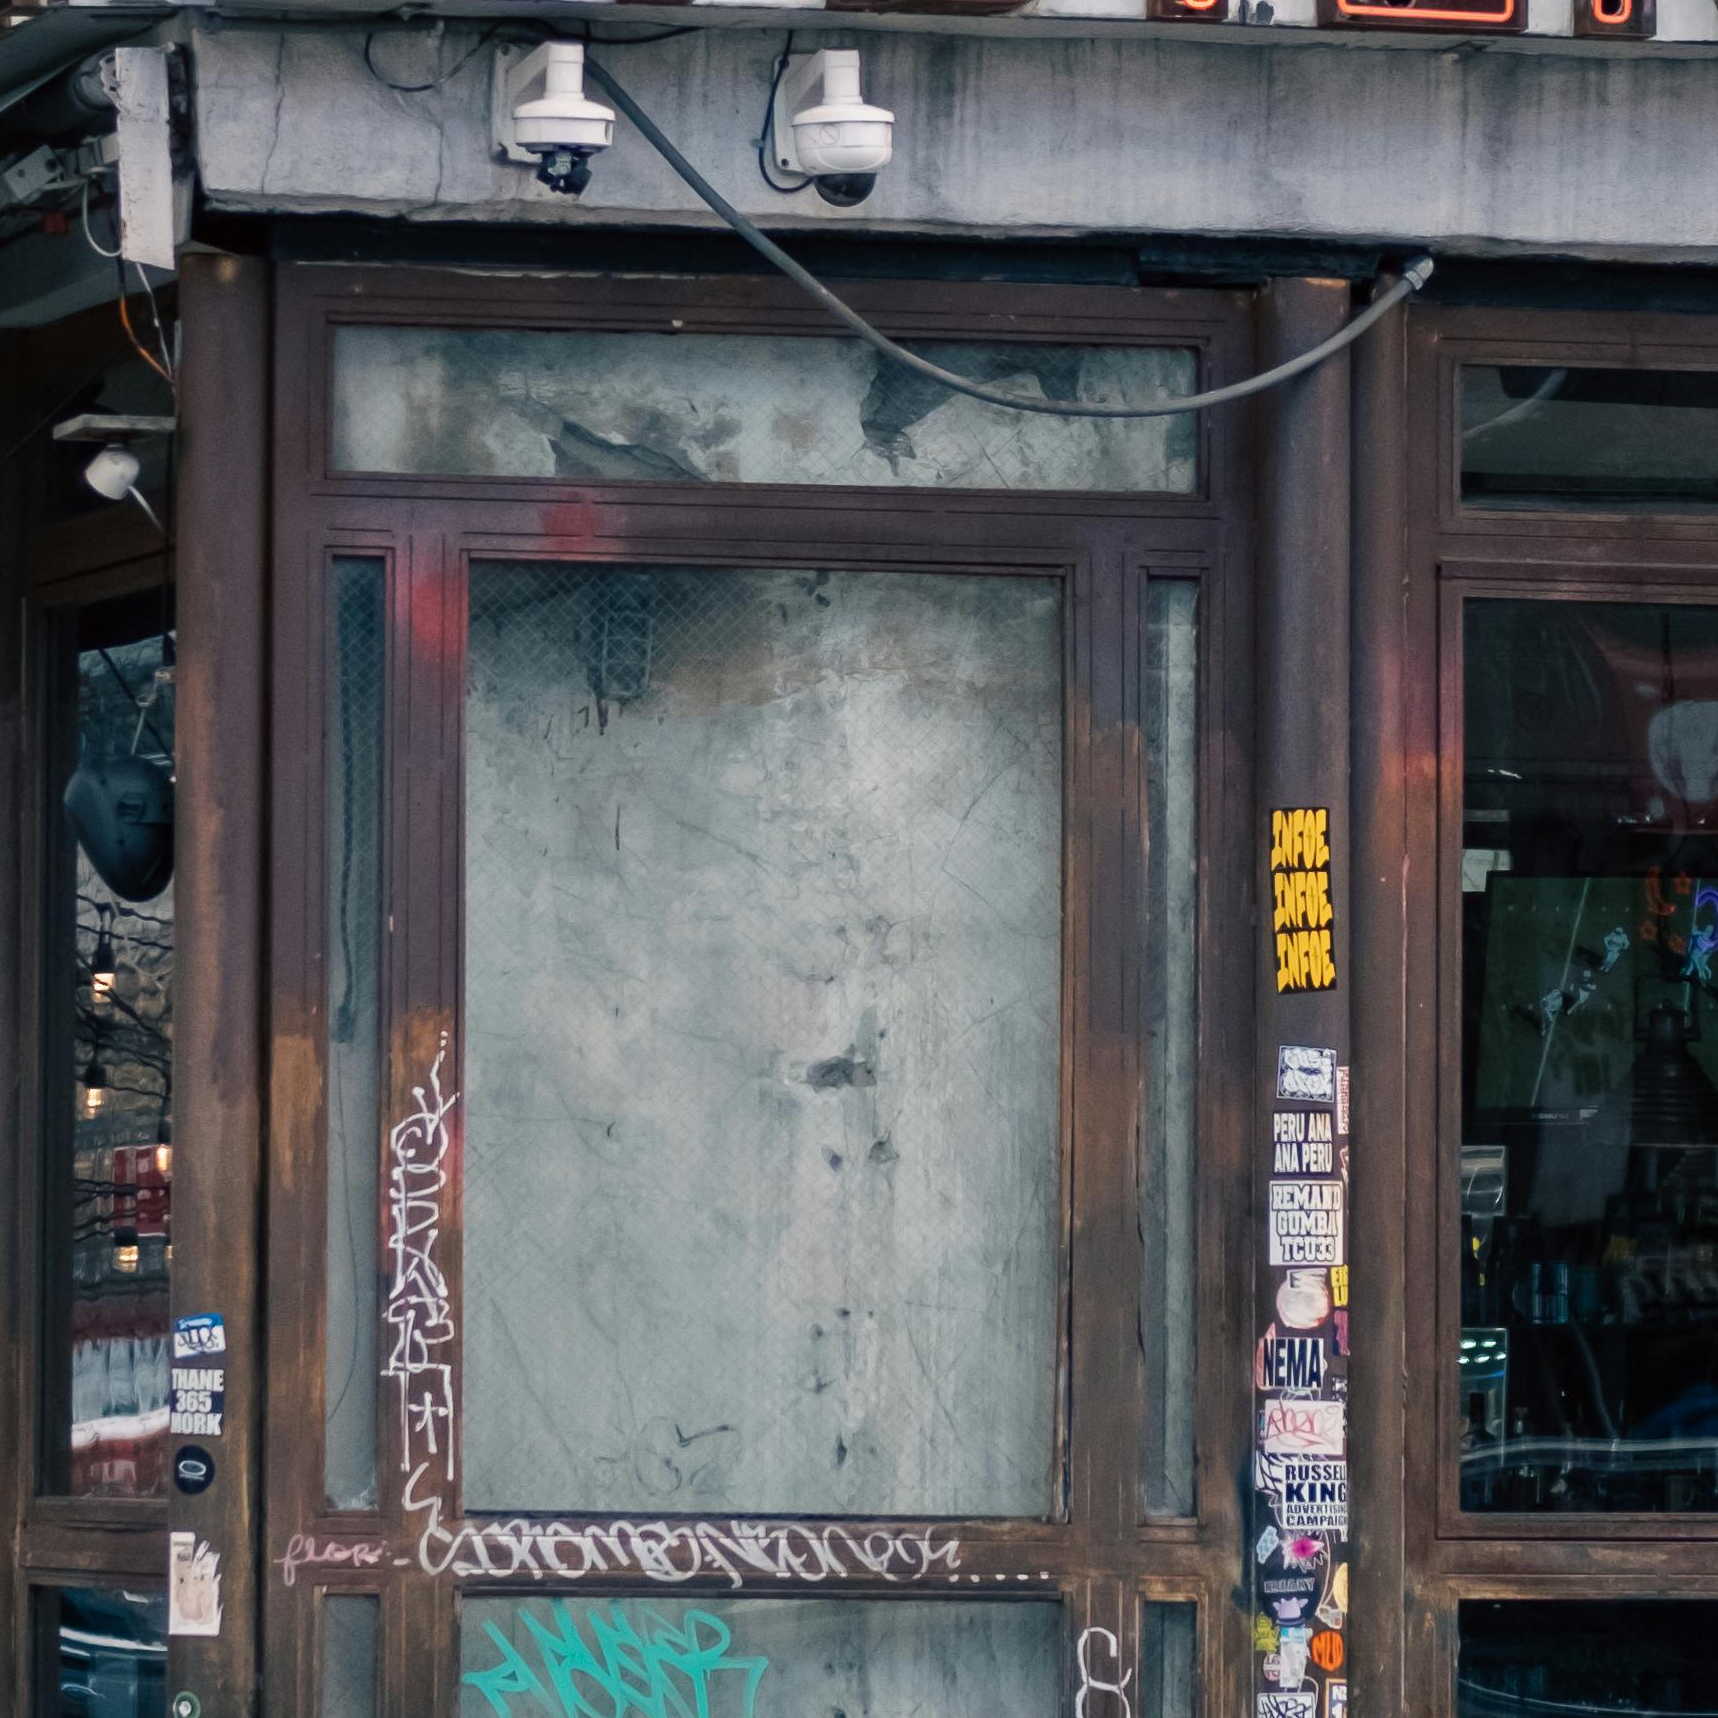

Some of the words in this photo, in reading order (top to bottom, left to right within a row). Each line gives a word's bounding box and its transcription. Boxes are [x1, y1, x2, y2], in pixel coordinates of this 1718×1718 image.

[1271, 809, 1329, 871] INFOE
[1274, 871, 1332, 932] INFOE
[1277, 930, 1335, 993] INFOE
[1274, 1112, 1305, 1142] PERU
[1308, 1112, 1333, 1142] ANA
[1274, 1143, 1300, 1173] ANA
[1302, 1142, 1333, 1173] PERU
[1272, 1184, 1341, 1211] REMAND
[1263, 1338, 1324, 1388] NEMA
[176, 1390, 212, 1412] 365
